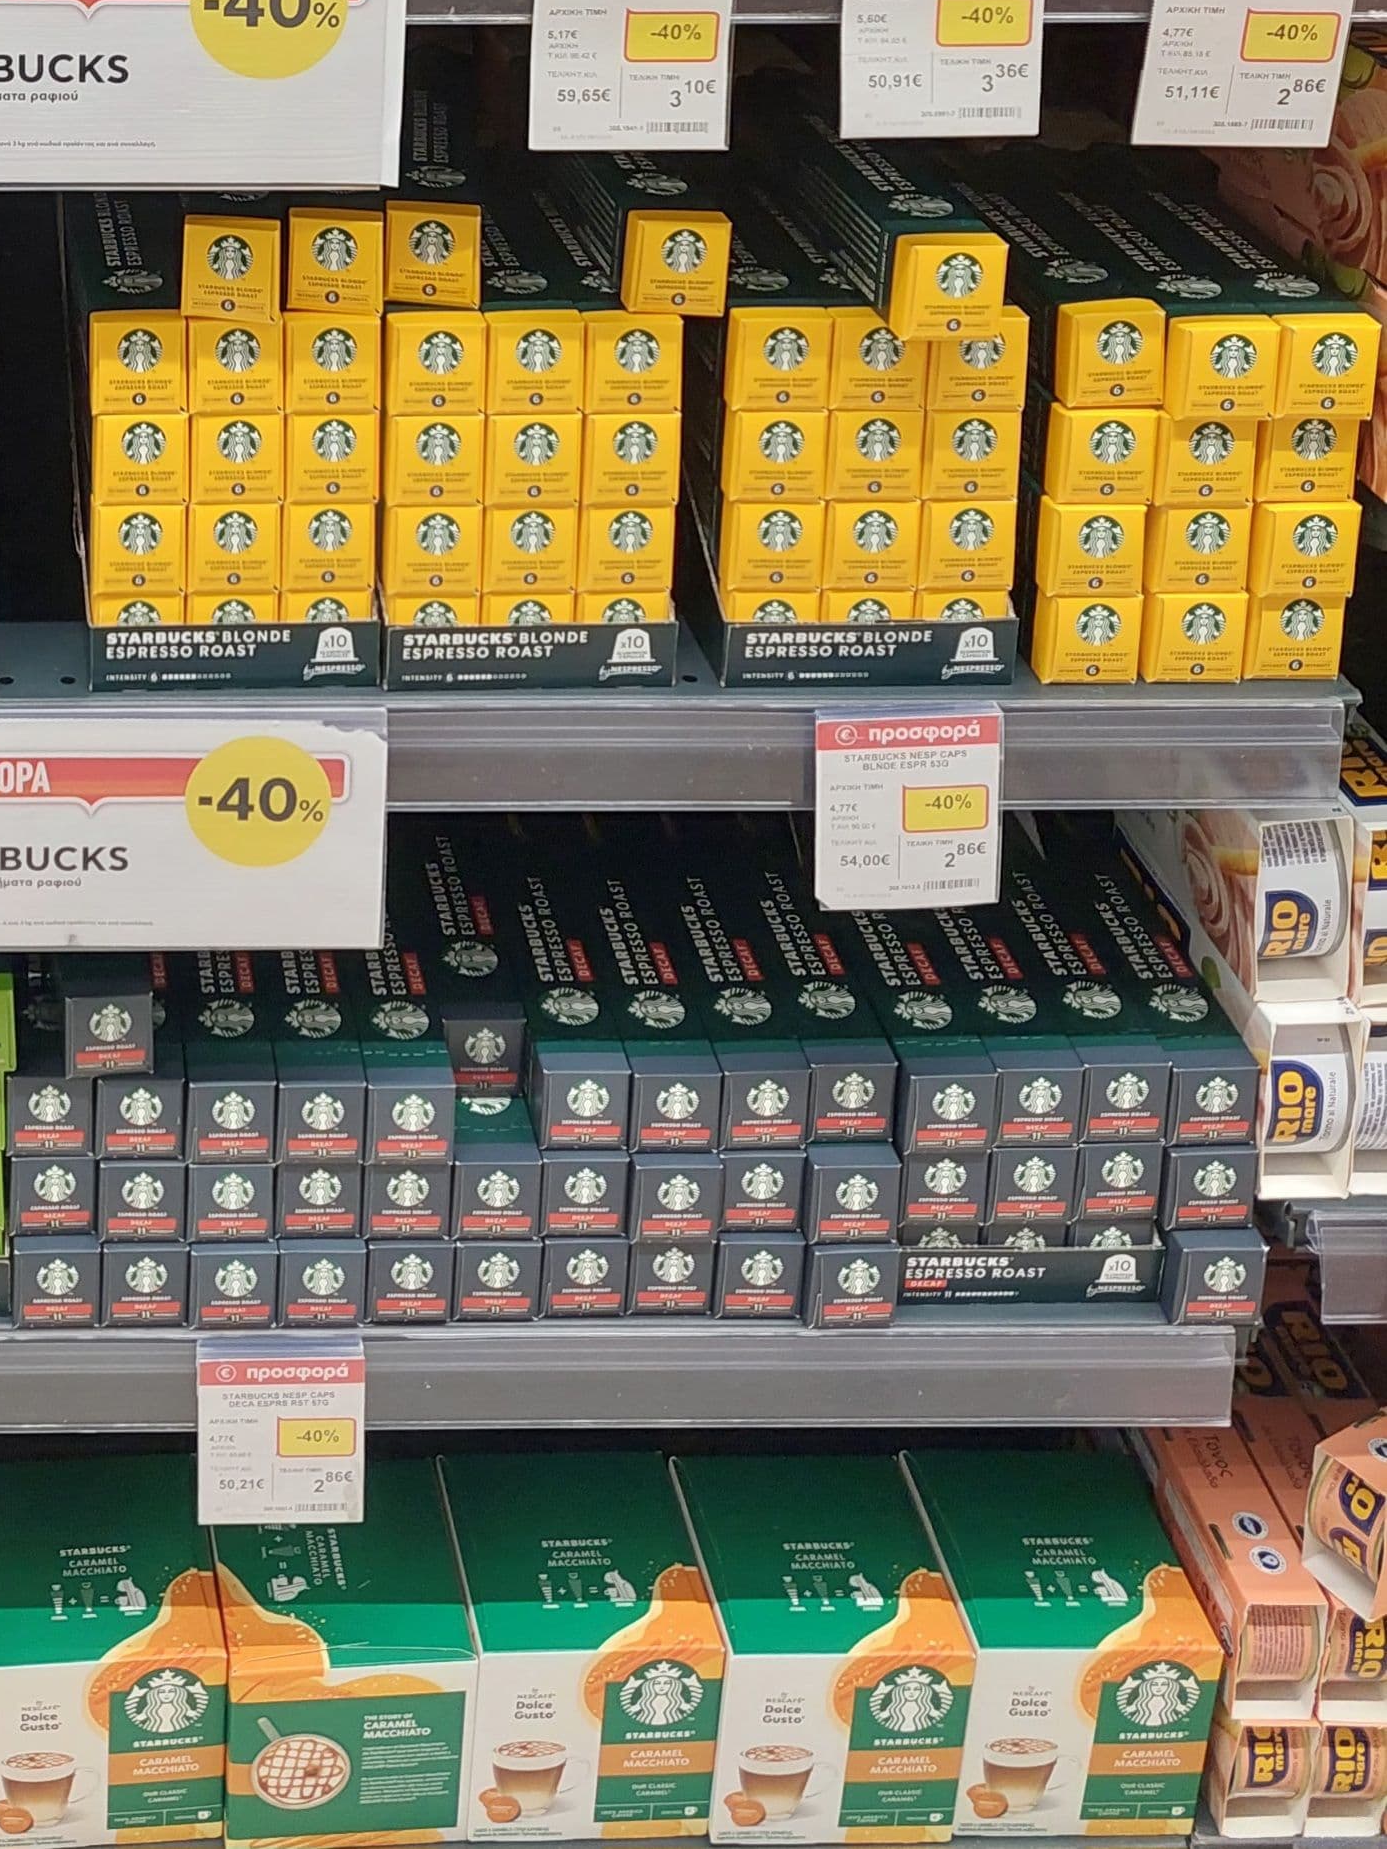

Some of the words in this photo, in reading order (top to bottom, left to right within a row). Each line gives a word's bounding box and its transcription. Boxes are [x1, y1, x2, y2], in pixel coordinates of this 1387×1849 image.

[961, 6, 1014, 25] -40%
[651, 23, 702, 42] -40%
[1267, 24, 1318, 41] -40%
[868, 74, 923, 91] 50,91€
[30, 89, 79, 104] ραφιού
[557, 88, 611, 105] 59,65€
[1165, 86, 1220, 100] 51,11€
[107, 632, 216, 645] STARBUCKS
[223, 629, 292, 643] BLONDE
[106, 644, 194, 660] ESPRESSO
[199, 644, 257, 658] ROAST
[868, 719, 981, 743] προσφορά
[198, 776, 325, 823] -40%
[925, 793, 972, 810] -40%
[840, 854, 891, 867] 54,00€
[1272, 1070, 1305, 1144] RIO
[1300, 1085, 1317, 1134] mare
[247, 1363, 349, 1383] προσφορά
[297, 1429, 340, 1444] -40%
[219, 1478, 264, 1491] 50,21€
[139, 1754, 193, 1767] CARAMEL
[133, 1763, 200, 1777] MACCHIATO
